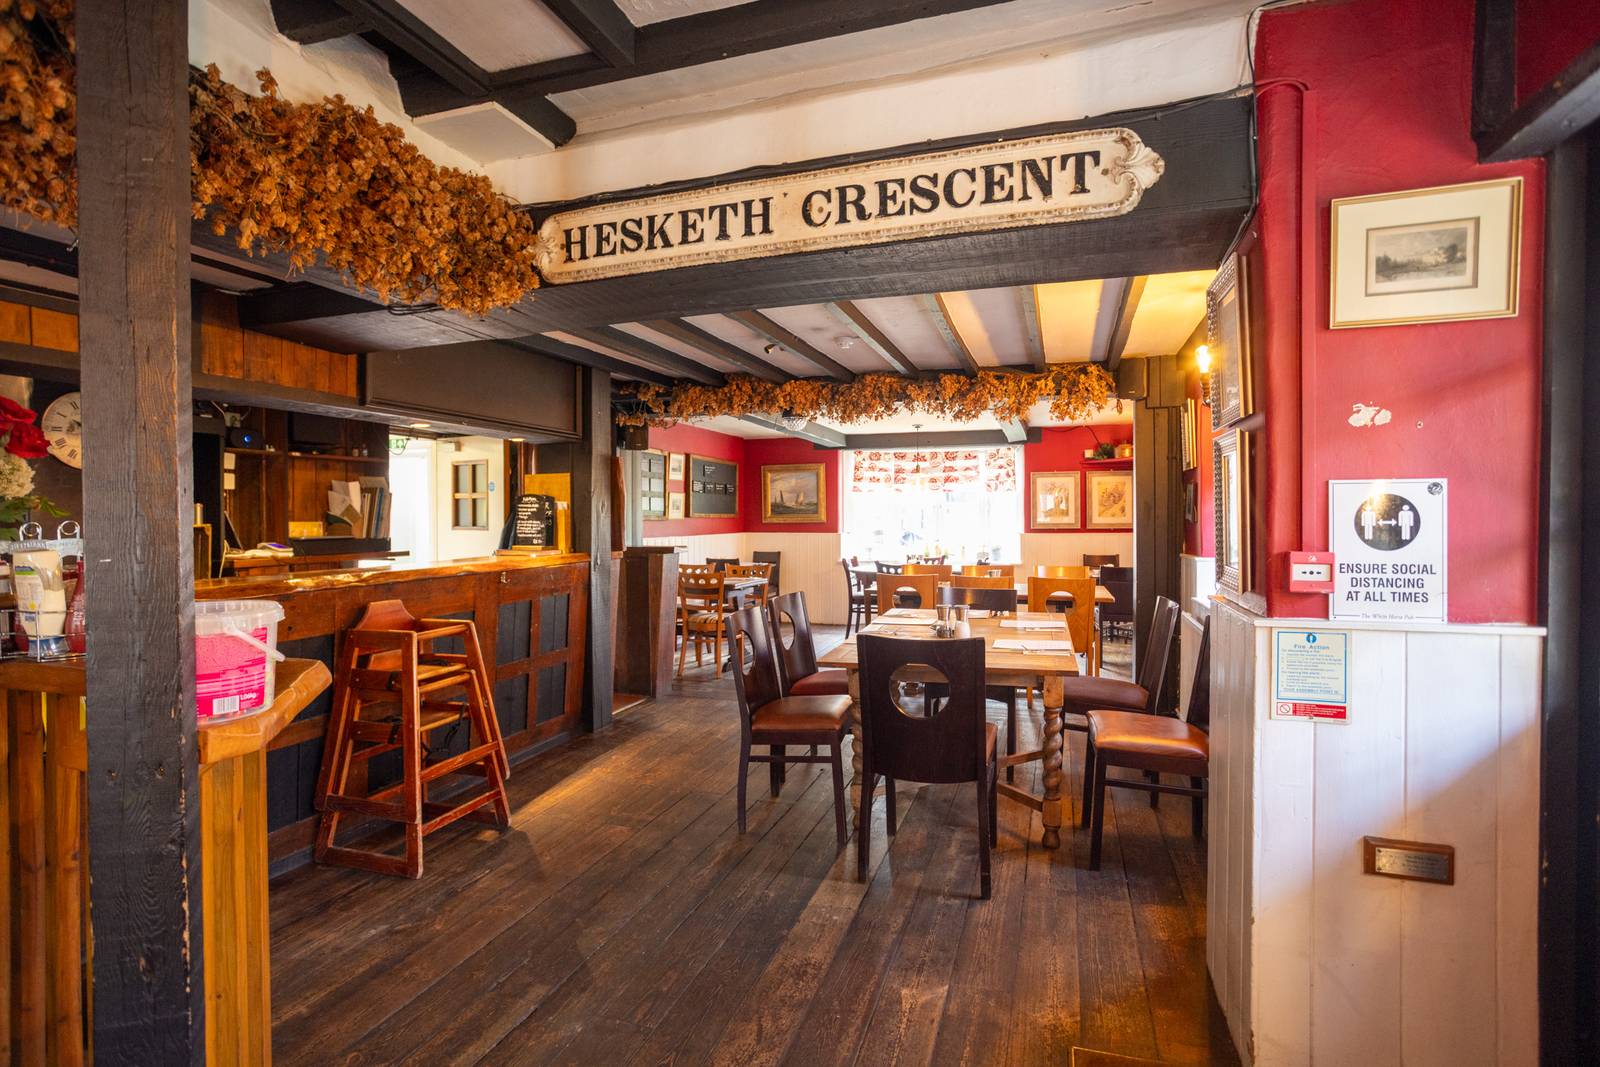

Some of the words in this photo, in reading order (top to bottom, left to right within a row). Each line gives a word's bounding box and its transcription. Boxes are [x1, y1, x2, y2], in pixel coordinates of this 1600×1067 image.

[563, 197, 772, 262] HESKETH
[802, 150, 1102, 229] CRESCENT
[1339, 563, 1387, 574] ENSURE
[1391, 563, 1437, 575] SOCIAL
[1350, 577, 1425, 589] DISTANCING
[1346, 591, 1360, 602] AT
[1364, 592, 1386, 602] ALL
[1390, 592, 1429, 603] TIMES
